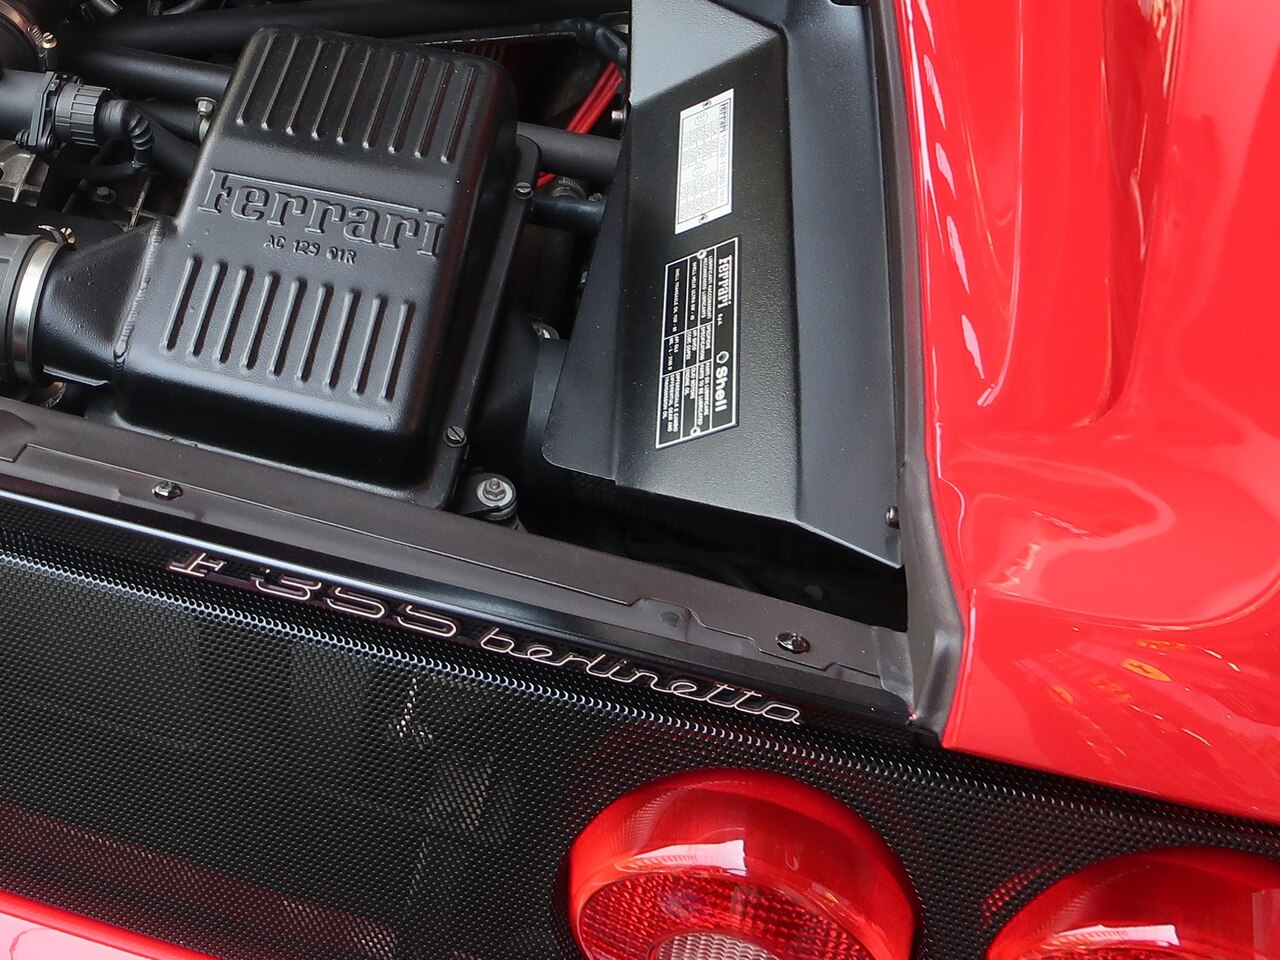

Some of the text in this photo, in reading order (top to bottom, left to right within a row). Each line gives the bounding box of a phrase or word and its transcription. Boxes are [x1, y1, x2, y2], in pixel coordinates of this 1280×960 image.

[198, 170, 447, 258] Ferrari
[264, 235, 286, 250] AC
[293, 239, 321, 257] 129
[718, 254, 732, 309] Ferrari
[715, 365, 728, 412] Shell
[480, 627, 801, 725] berlinetta
